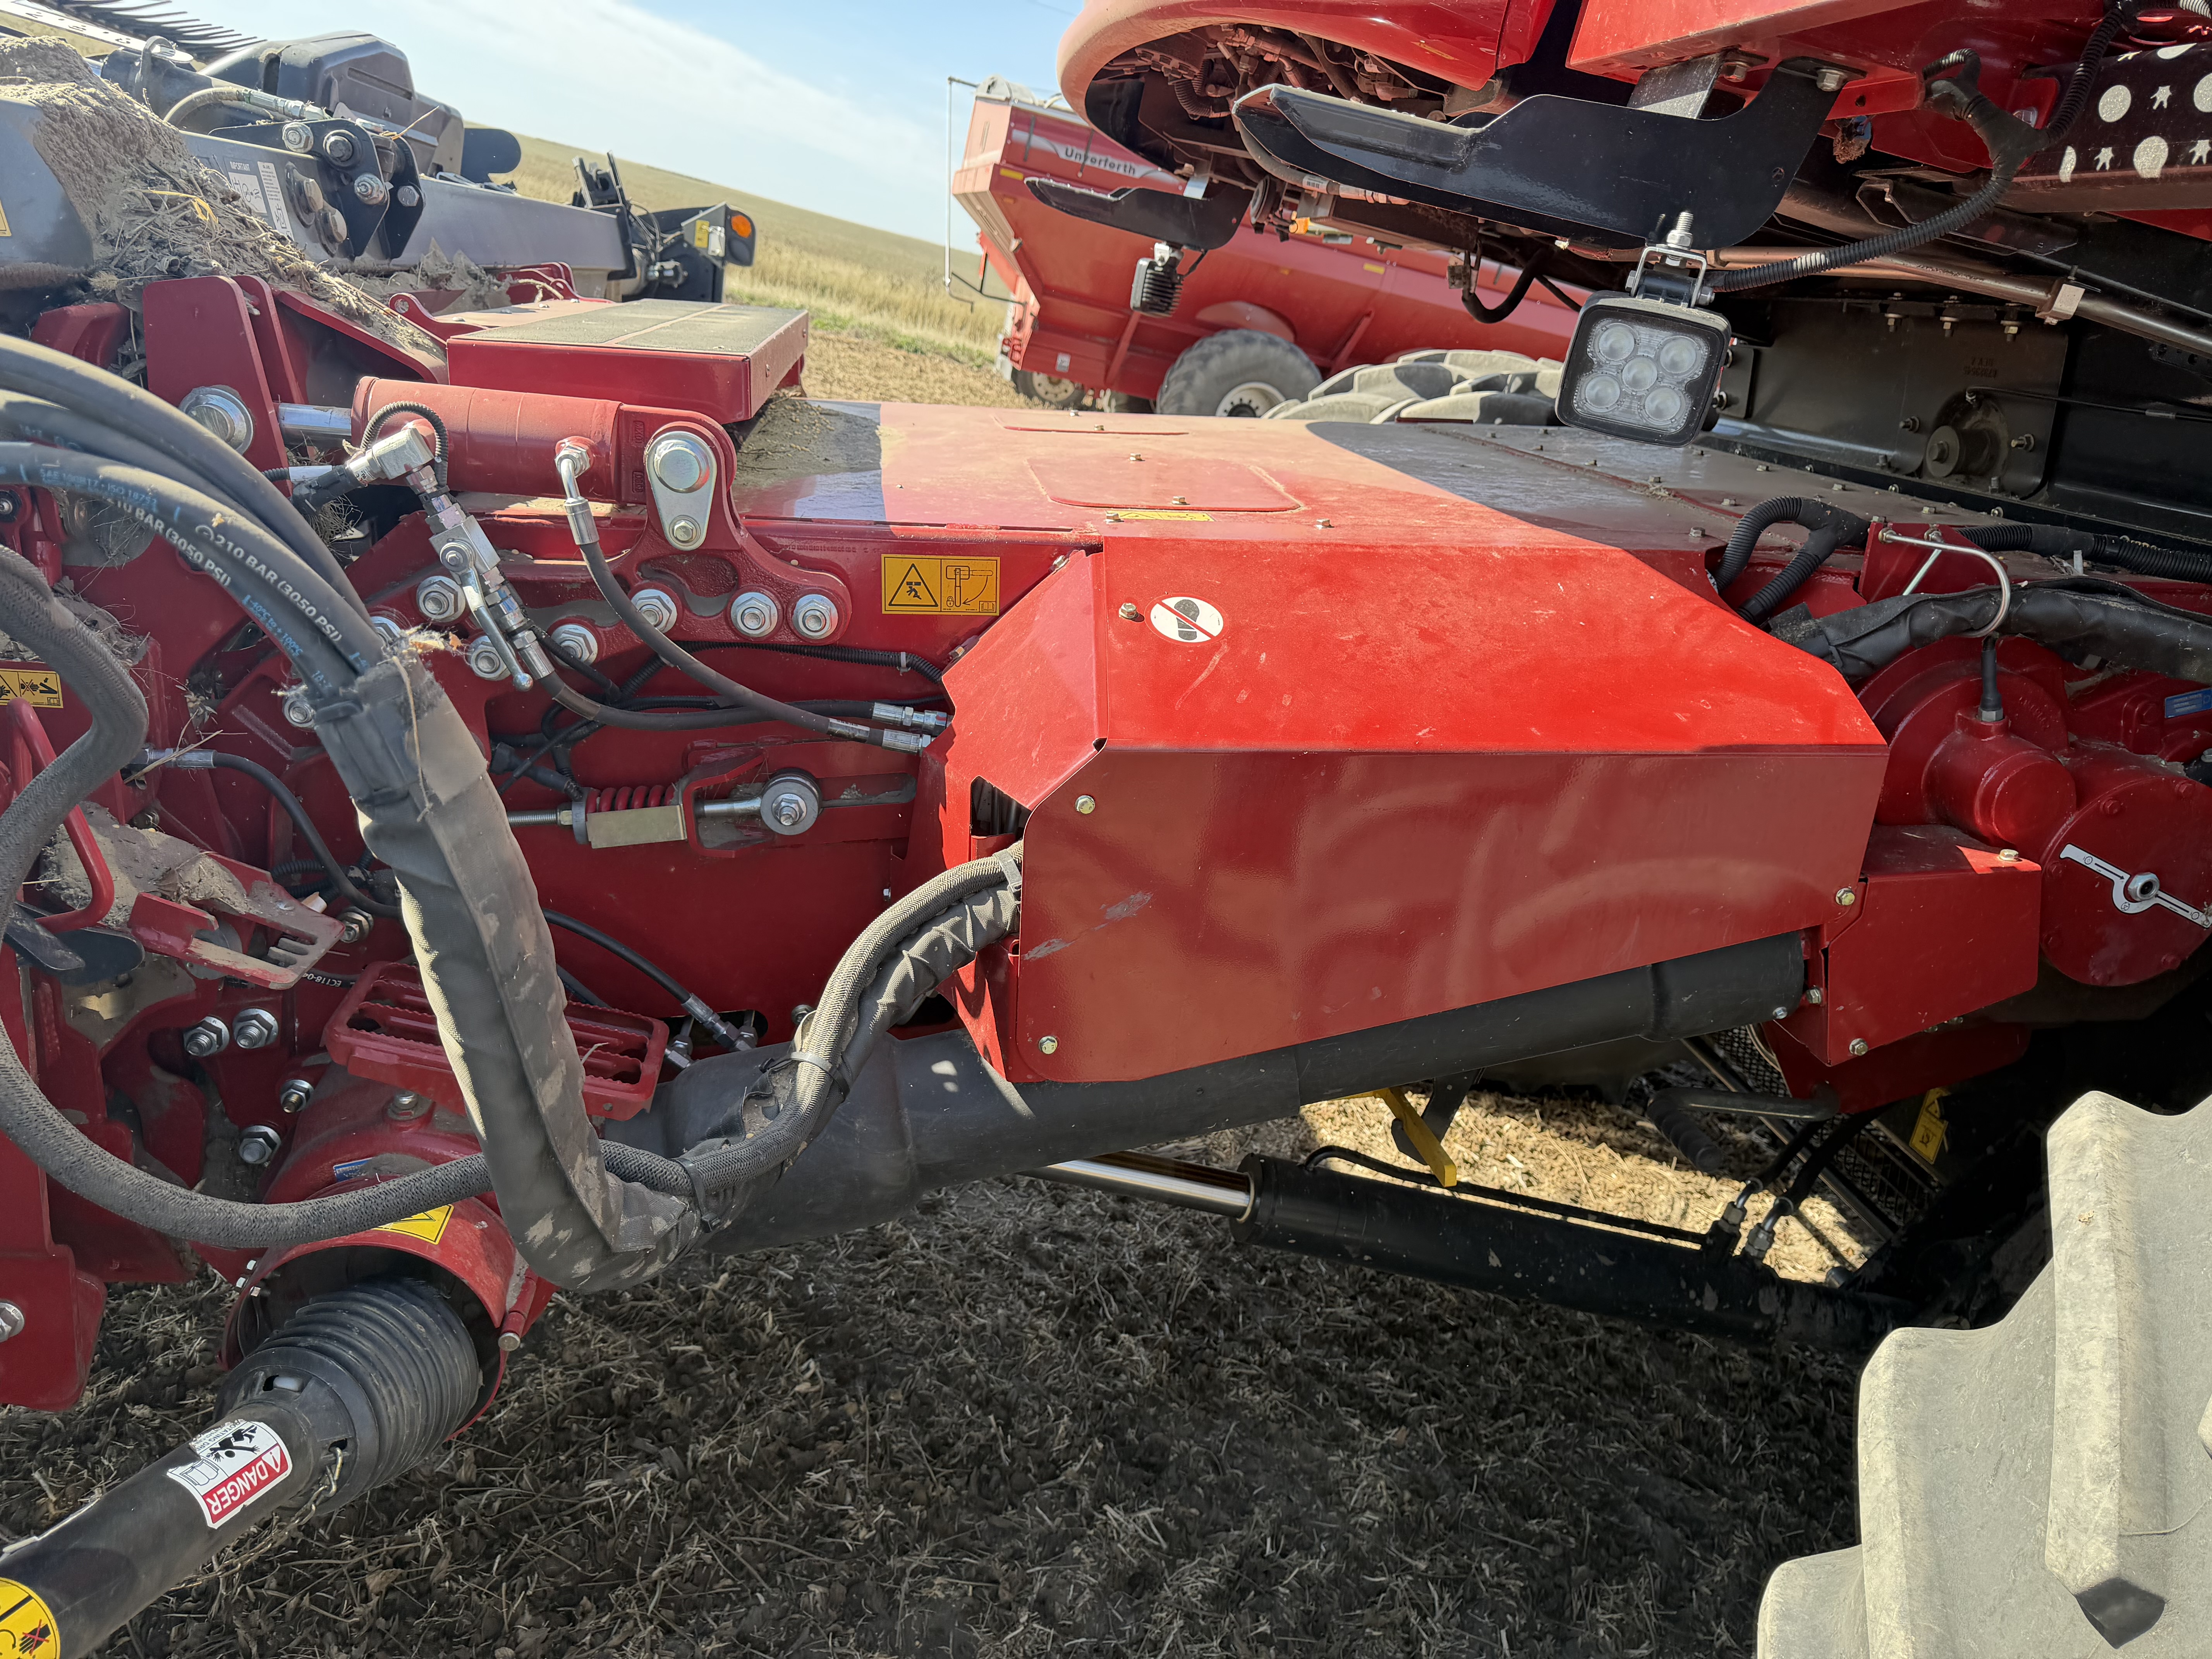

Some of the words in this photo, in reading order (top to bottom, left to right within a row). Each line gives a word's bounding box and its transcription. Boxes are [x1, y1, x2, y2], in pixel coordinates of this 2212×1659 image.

[230, 161, 251, 171] IMPORTANT
[1065, 146, 1135, 176] Unerferth
[136, 507, 165, 533] BAR
[166, 528, 204, 563] (3050
[204, 559, 231, 586] PSI)
[216, 534, 245, 558] 210
[246, 555, 278, 584] BAR
[277, 581, 317, 617] (3050
[315, 616, 342, 641] PSI)
[206, 1463, 269, 1515] DANGER
